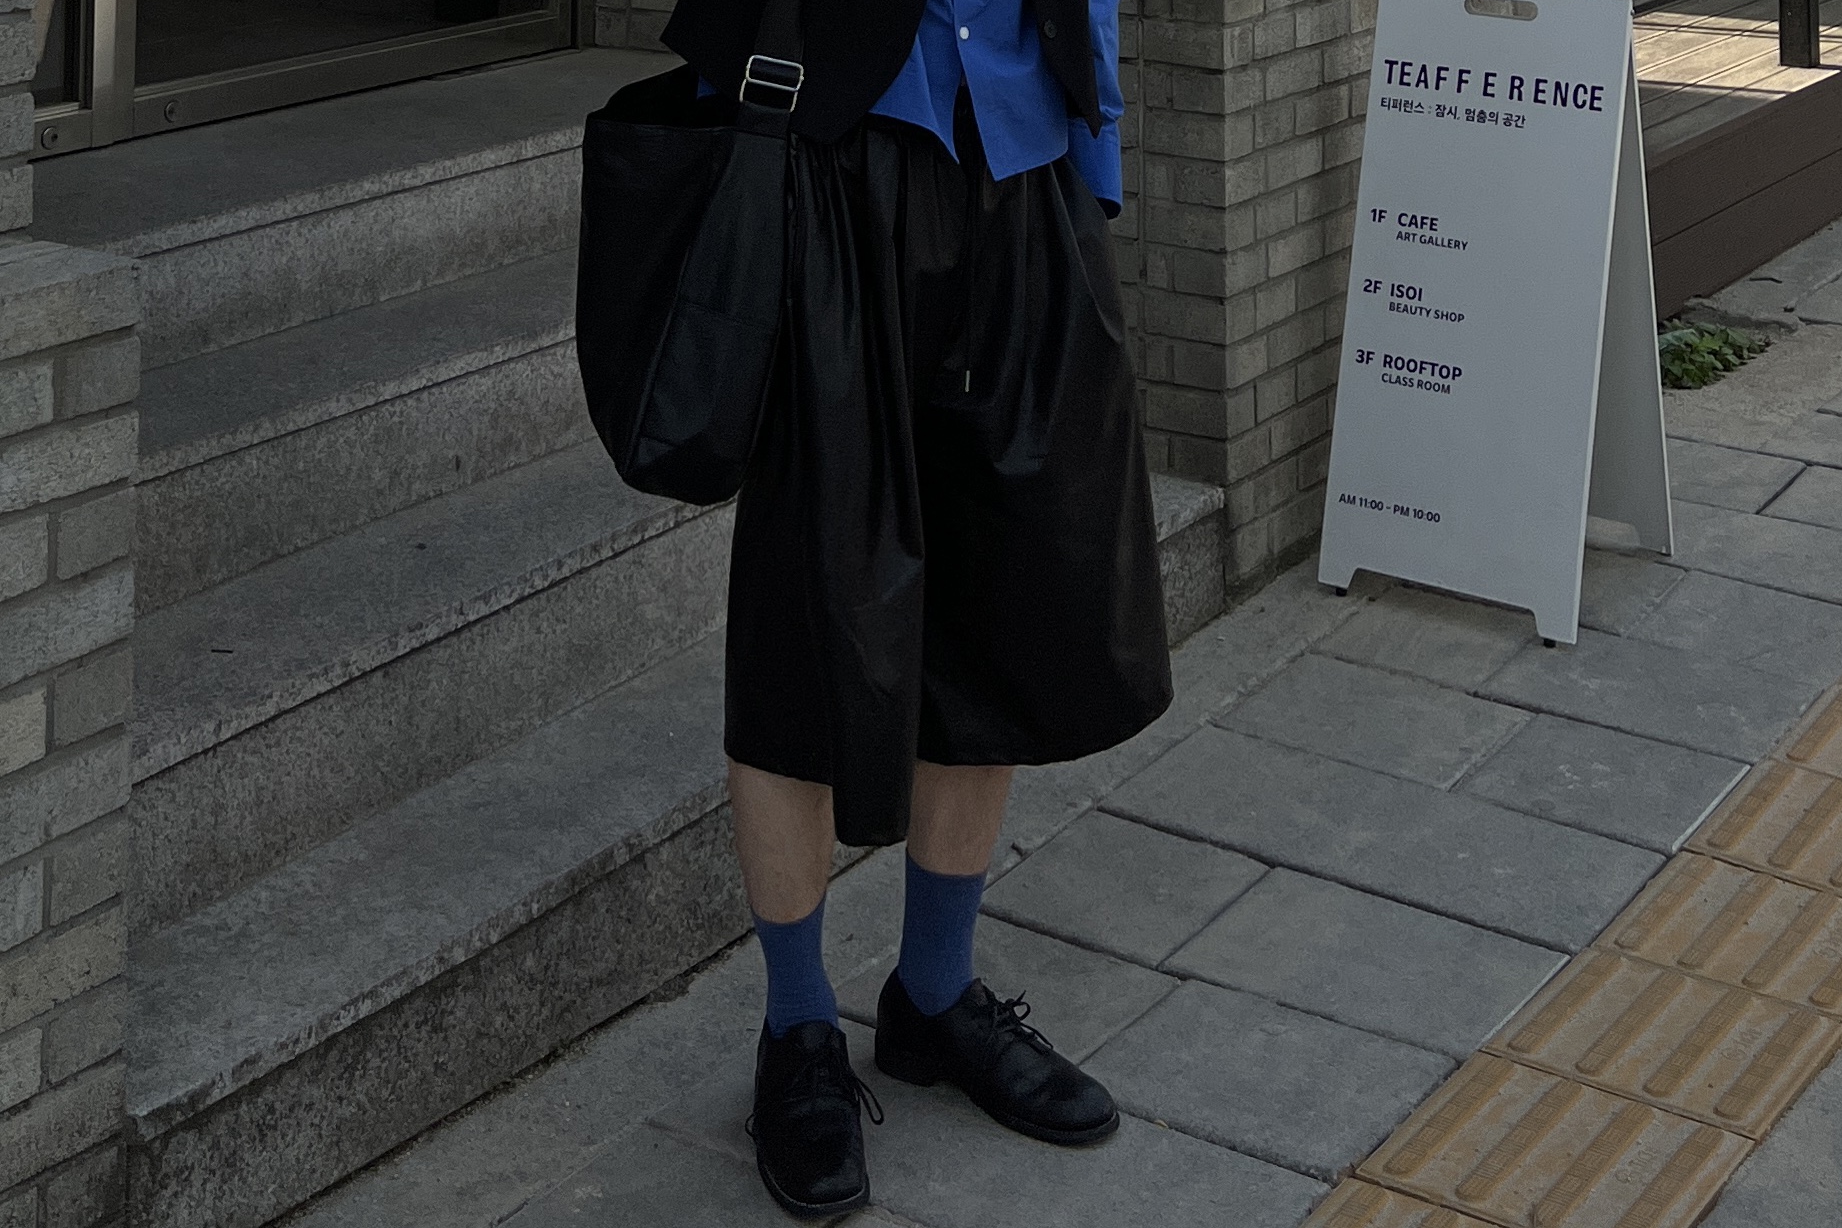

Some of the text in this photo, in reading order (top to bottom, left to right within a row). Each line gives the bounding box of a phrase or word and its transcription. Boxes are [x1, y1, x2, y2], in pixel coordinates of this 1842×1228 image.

[1384, 59, 1605, 112] TEAFFERENCE
[1380, 97, 1425, 115] 티퍼런스
[1434, 104, 1461, 121] 잠시,
[1464, 108, 1499, 126] 멈춤의
[1502, 112, 1527, 129] 공간
[1370, 208, 1439, 232] 1F CAFE
[1396, 230, 1468, 251] ART GALLERY
[1363, 279, 1423, 302] 2F ISOI
[1388, 301, 1465, 323] BEAUTY SHOP
[1355, 348, 1463, 381] 3F ROOFTOP
[1381, 372, 1451, 395] CLASS ROOM
[1338, 493, 1356, 506] AM
[1359, 497, 1384, 511] 11:00
[1393, 504, 1410, 517] PM
[1413, 508, 1441, 523] 10:00
